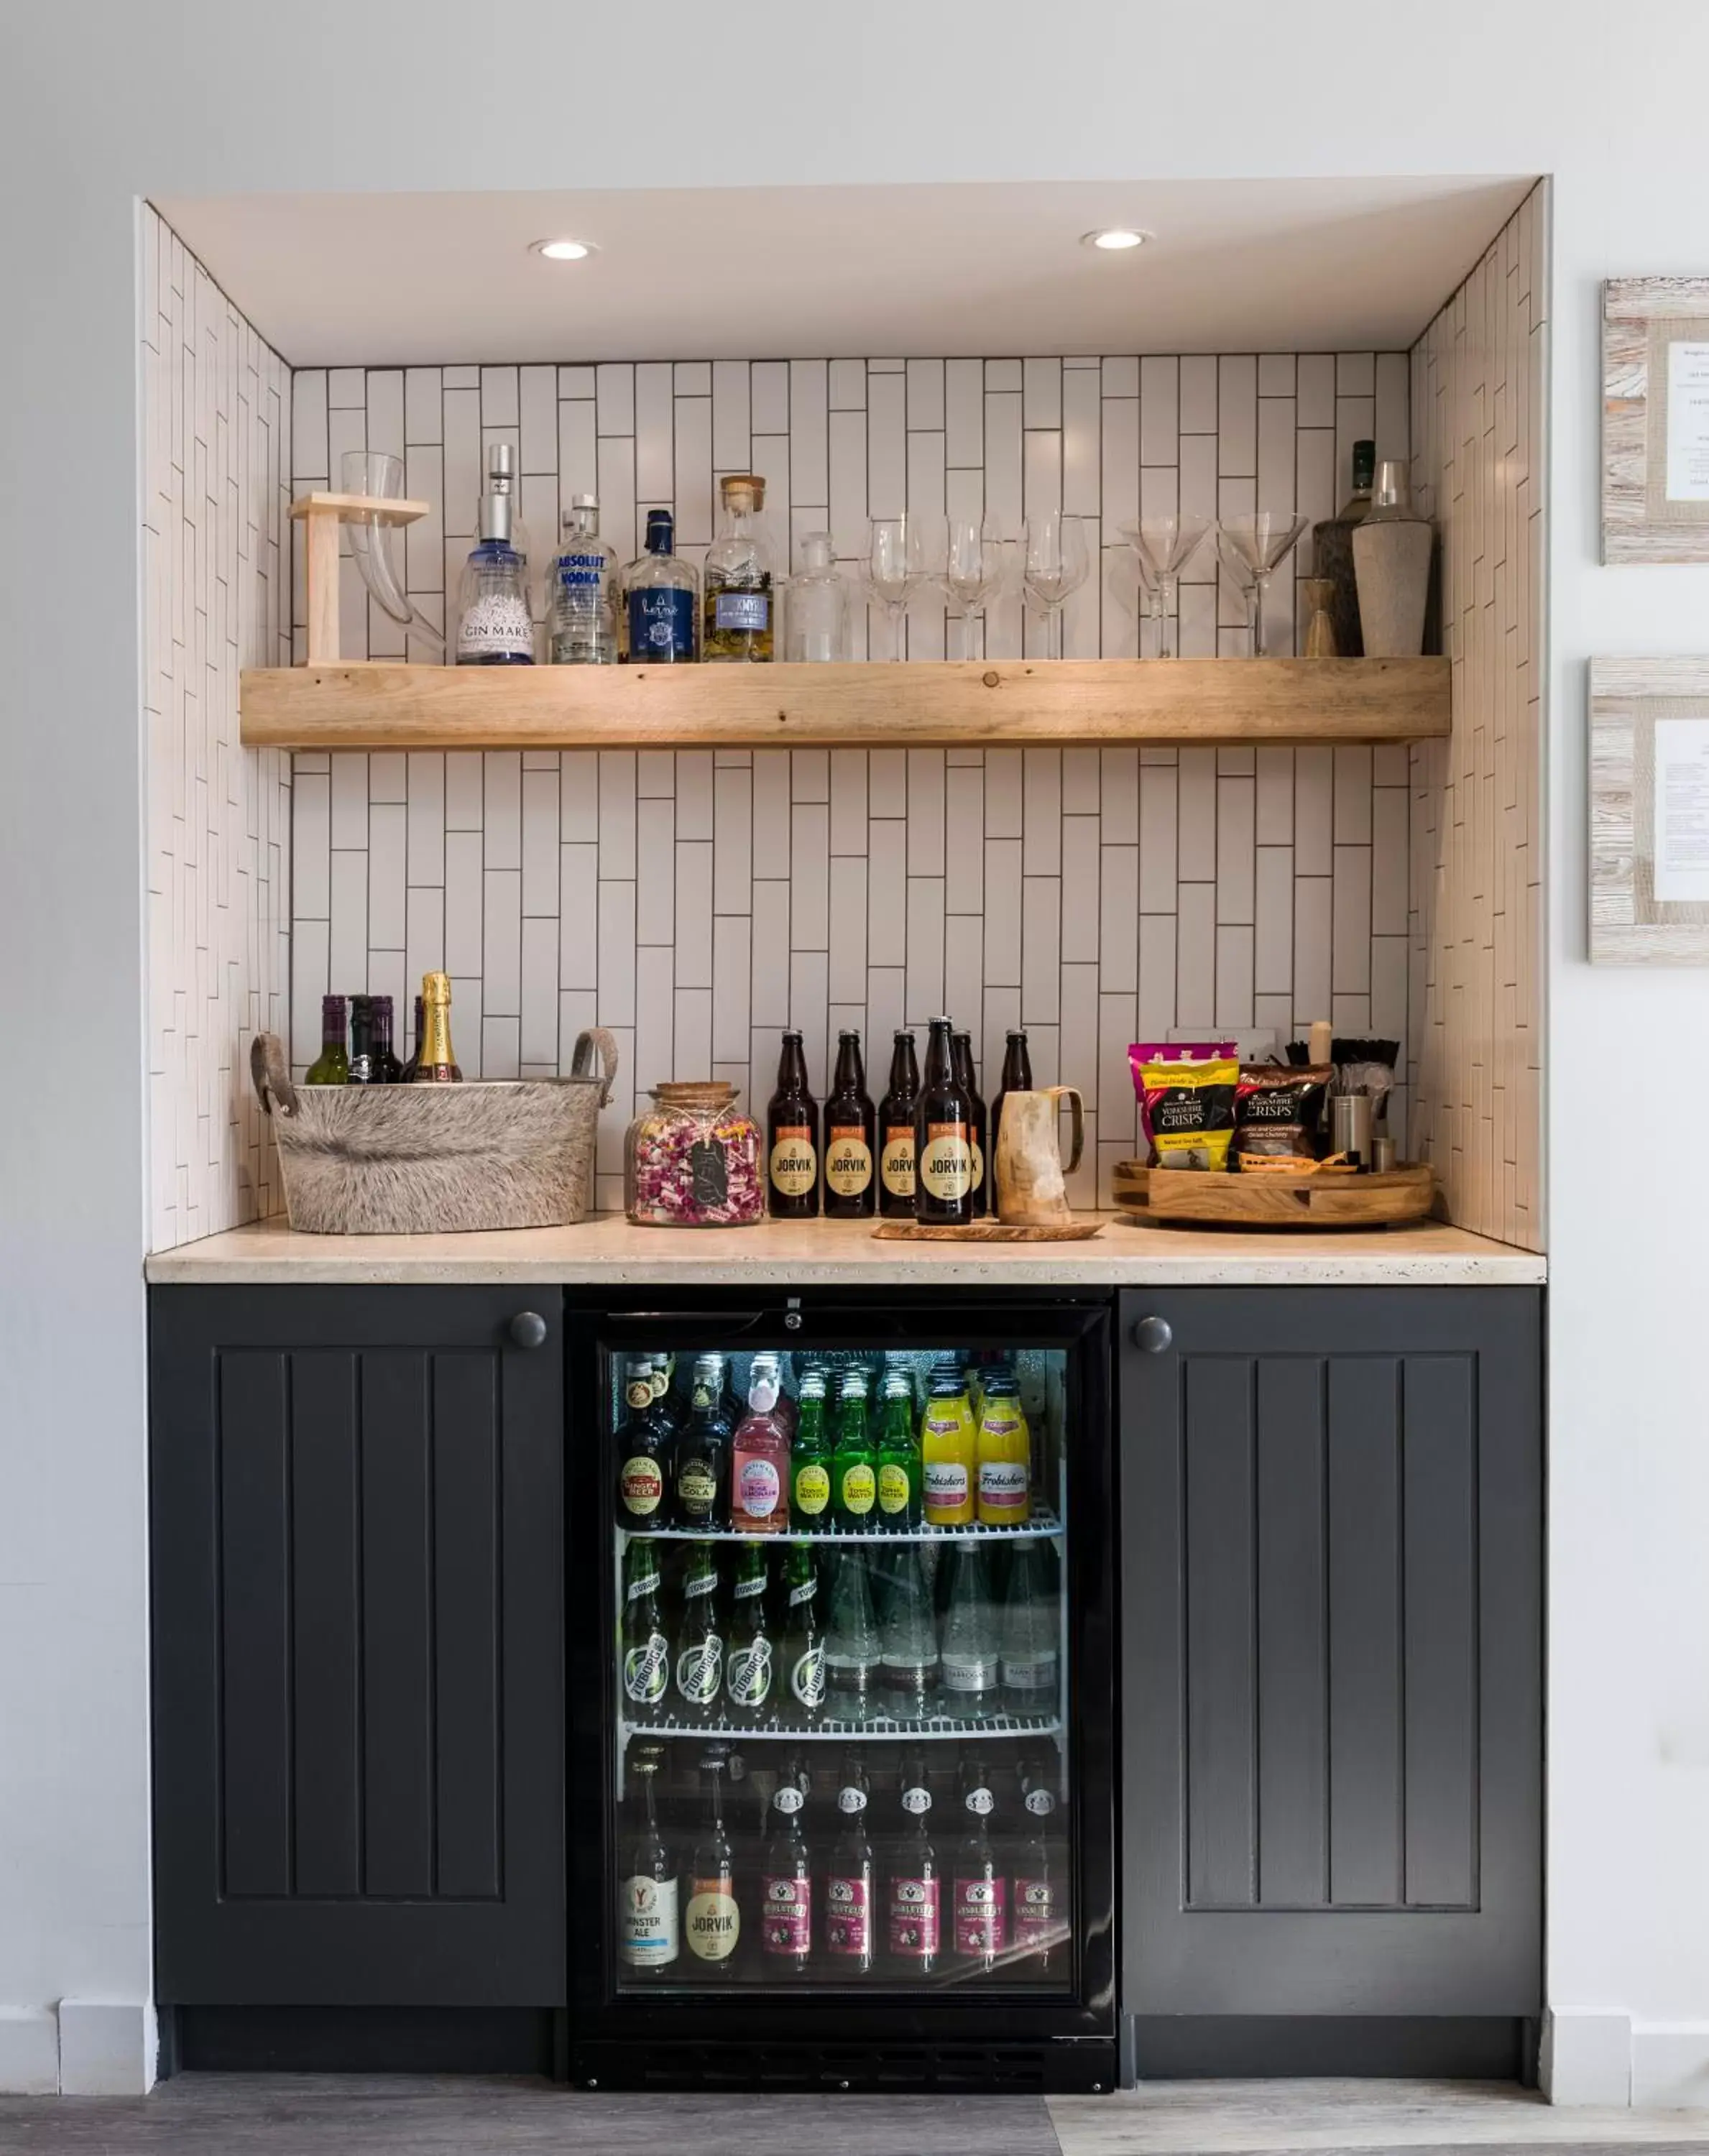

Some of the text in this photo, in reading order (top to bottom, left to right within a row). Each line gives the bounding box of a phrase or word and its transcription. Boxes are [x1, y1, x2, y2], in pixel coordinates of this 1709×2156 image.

[558, 555, 605, 568] ABSOLUT
[561, 572, 600, 584] VODKA
[465, 625, 529, 638] GIN MARE
[1247, 1106, 1292, 1116] CRISPS
[1161, 1113, 1203, 1126] CRISPS
[776, 1158, 811, 1172] JORVIK
[830, 1158, 866, 1172] JORVIK
[886, 1158, 915, 1172] JORV
[929, 1158, 967, 1174] JORVIK
[683, 1486, 709, 1496] COLA
[632, 1649, 662, 1696] TUBORG
[684, 1650, 717, 1695] TUBORG
[734, 1653, 765, 1697] TUBORG
[692, 1915, 733, 1932] JORVIK
[635, 1928, 650, 1937] ALE
